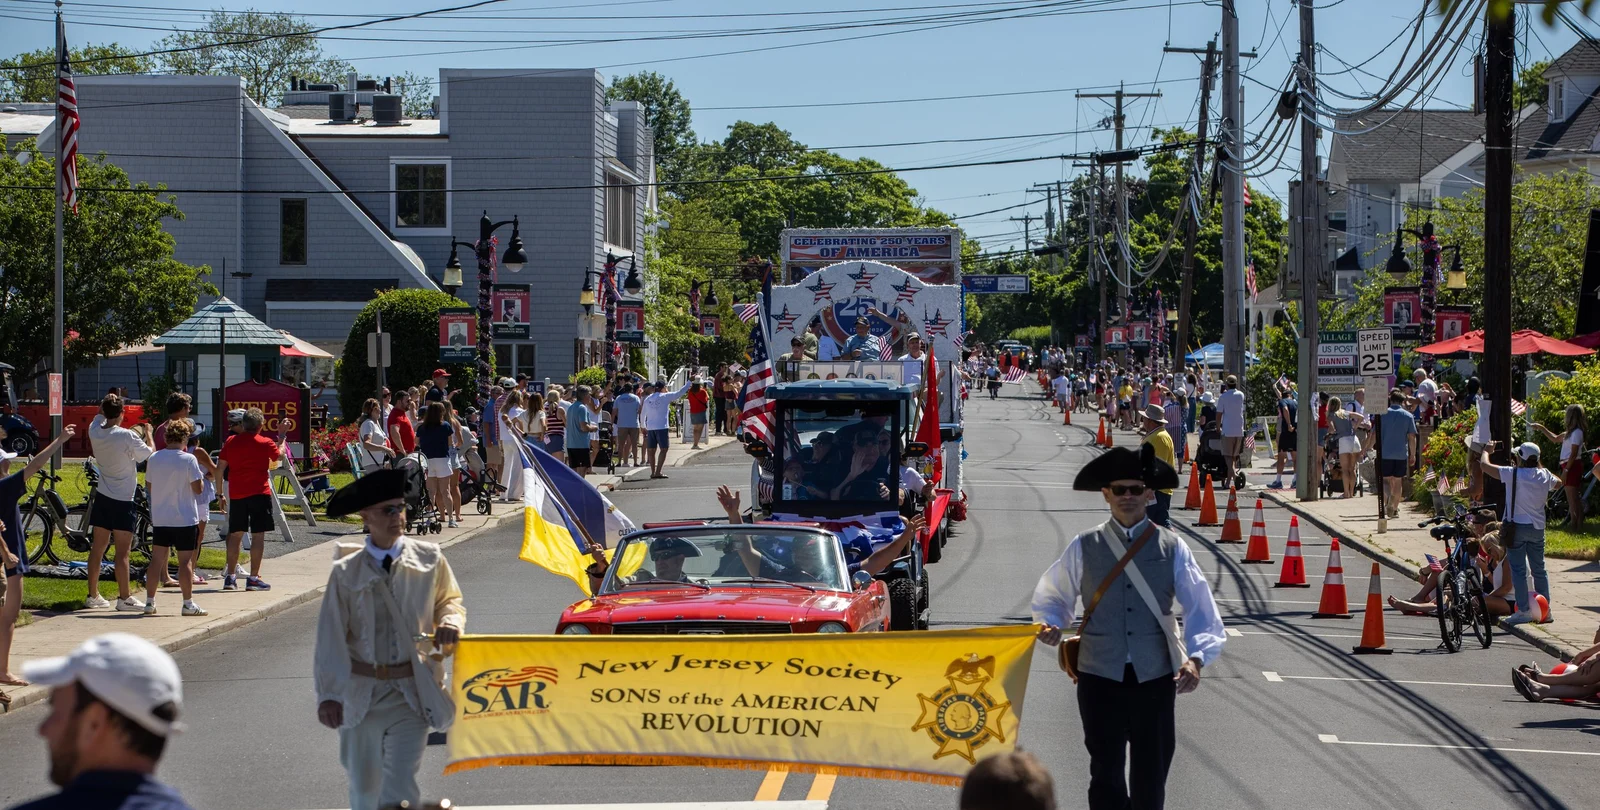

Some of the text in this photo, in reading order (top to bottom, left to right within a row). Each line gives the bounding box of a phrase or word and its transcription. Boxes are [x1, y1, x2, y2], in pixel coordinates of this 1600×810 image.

[794, 236, 945, 246] CELEBRATING 250 YEARS
[820, 247, 920, 258] OF AMERICA
[838, 297, 894, 317] 250
[1360, 333, 1390, 342] SPEED
[1322, 345, 1354, 353] US POST
[1364, 343, 1387, 352] LIMIT
[1319, 357, 1350, 365] GIANNI'S
[1362, 353, 1390, 372] 25
[576, 654, 902, 690] New Jersey Society
[463, 680, 549, 715] SAR
[591, 687, 880, 713] SONS of the AMERICAN
[965, 696, 976, 704] ET
[938, 695, 958, 732] LIBERTAS
[972, 706, 985, 733] PATRIA
[641, 712, 823, 738] REVOLUTION
